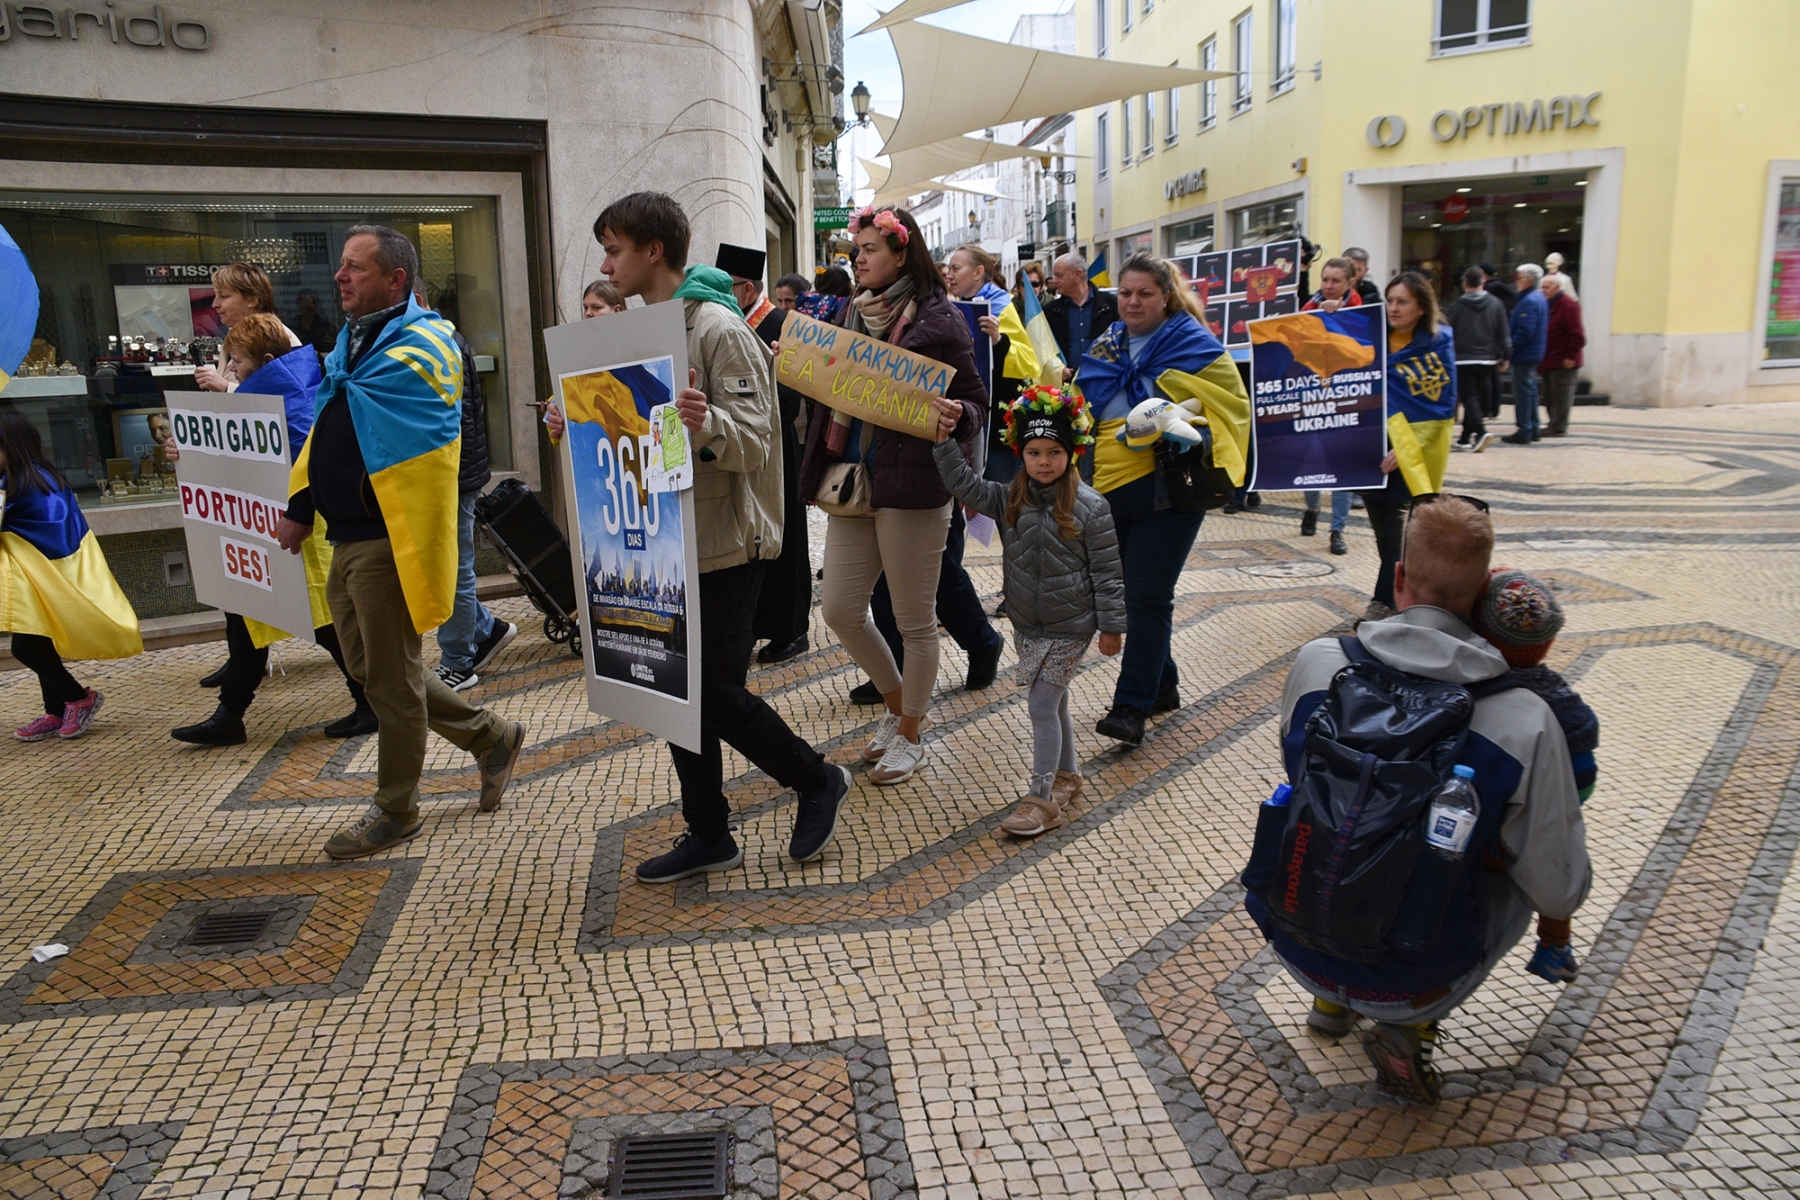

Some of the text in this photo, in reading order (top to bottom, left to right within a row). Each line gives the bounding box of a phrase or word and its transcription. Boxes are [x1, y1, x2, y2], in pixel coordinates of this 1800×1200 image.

[1431, 92, 1601, 142] OPTIMAX
[1347, 172, 1355, 184] 2
[833, 208, 853, 216] COLO
[170, 265, 227, 277] TISSO
[779, 345, 799, 376] É
[797, 358, 813, 385] A
[787, 318, 947, 396] NOVA KAKHOVKA
[1256, 370, 1382, 395] 365 DAYS OF RUSSIA'S
[1256, 383, 1372, 405] FULL-SCALE INVASION
[1256, 406, 1265, 417] 9
[1266, 402, 1301, 416] YEARS
[1302, 402, 1336, 417] WAR
[1293, 412, 1359, 433] UKRAINE
[174, 413, 282, 456] OBRIGADO
[627, 533, 643, 547] DIAS
[225, 543, 272, 587] SES!
[593, 593, 600, 603] DE
[599, 594, 618, 605] INVASÃO
[617, 596, 624, 606] EM
[640, 599, 657, 611] ESCALA
[1284, 821, 1311, 913] patagonia
